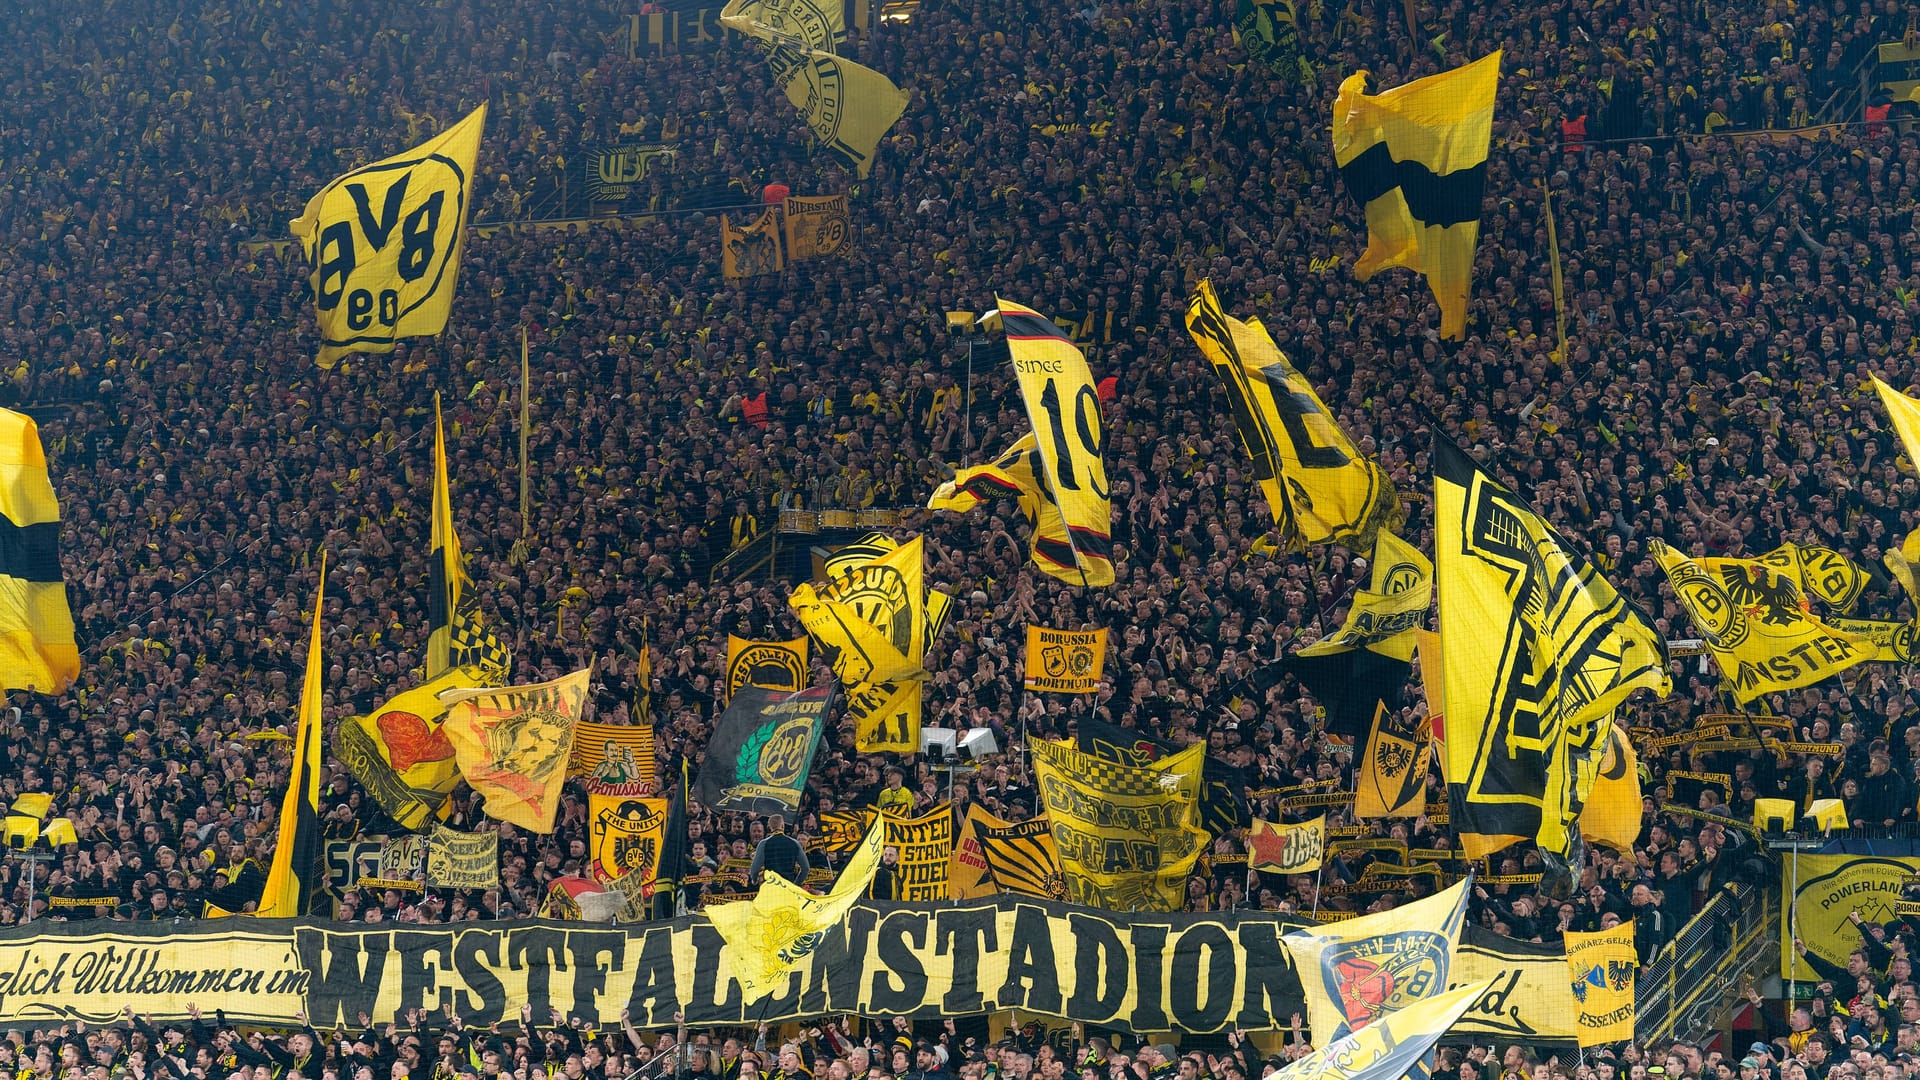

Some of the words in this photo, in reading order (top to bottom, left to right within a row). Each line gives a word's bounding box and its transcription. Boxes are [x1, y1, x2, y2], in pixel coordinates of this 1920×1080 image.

[788, 198, 844, 217] BIERSTADT
[816, 221, 842, 246] BVB
[1016, 359, 1063, 374] SINCE
[1040, 632, 1097, 646] BORUSSIA
[733, 649, 791, 694] ESTFALEN
[1035, 677, 1095, 689] DORTMUND
[607, 812, 626, 829] THE
[630, 814, 660, 830] UNITY
[987, 826, 1015, 836] THE
[627, 849, 645, 862] BVB
[1821, 880, 1904, 910] POWERLAN
[71, 945, 266, 995] Willkommen
[266, 953, 312, 996] im
[299, 905, 1310, 1034] WESTFALNSTADION
[1578, 1002, 1634, 1029] ESSENER
